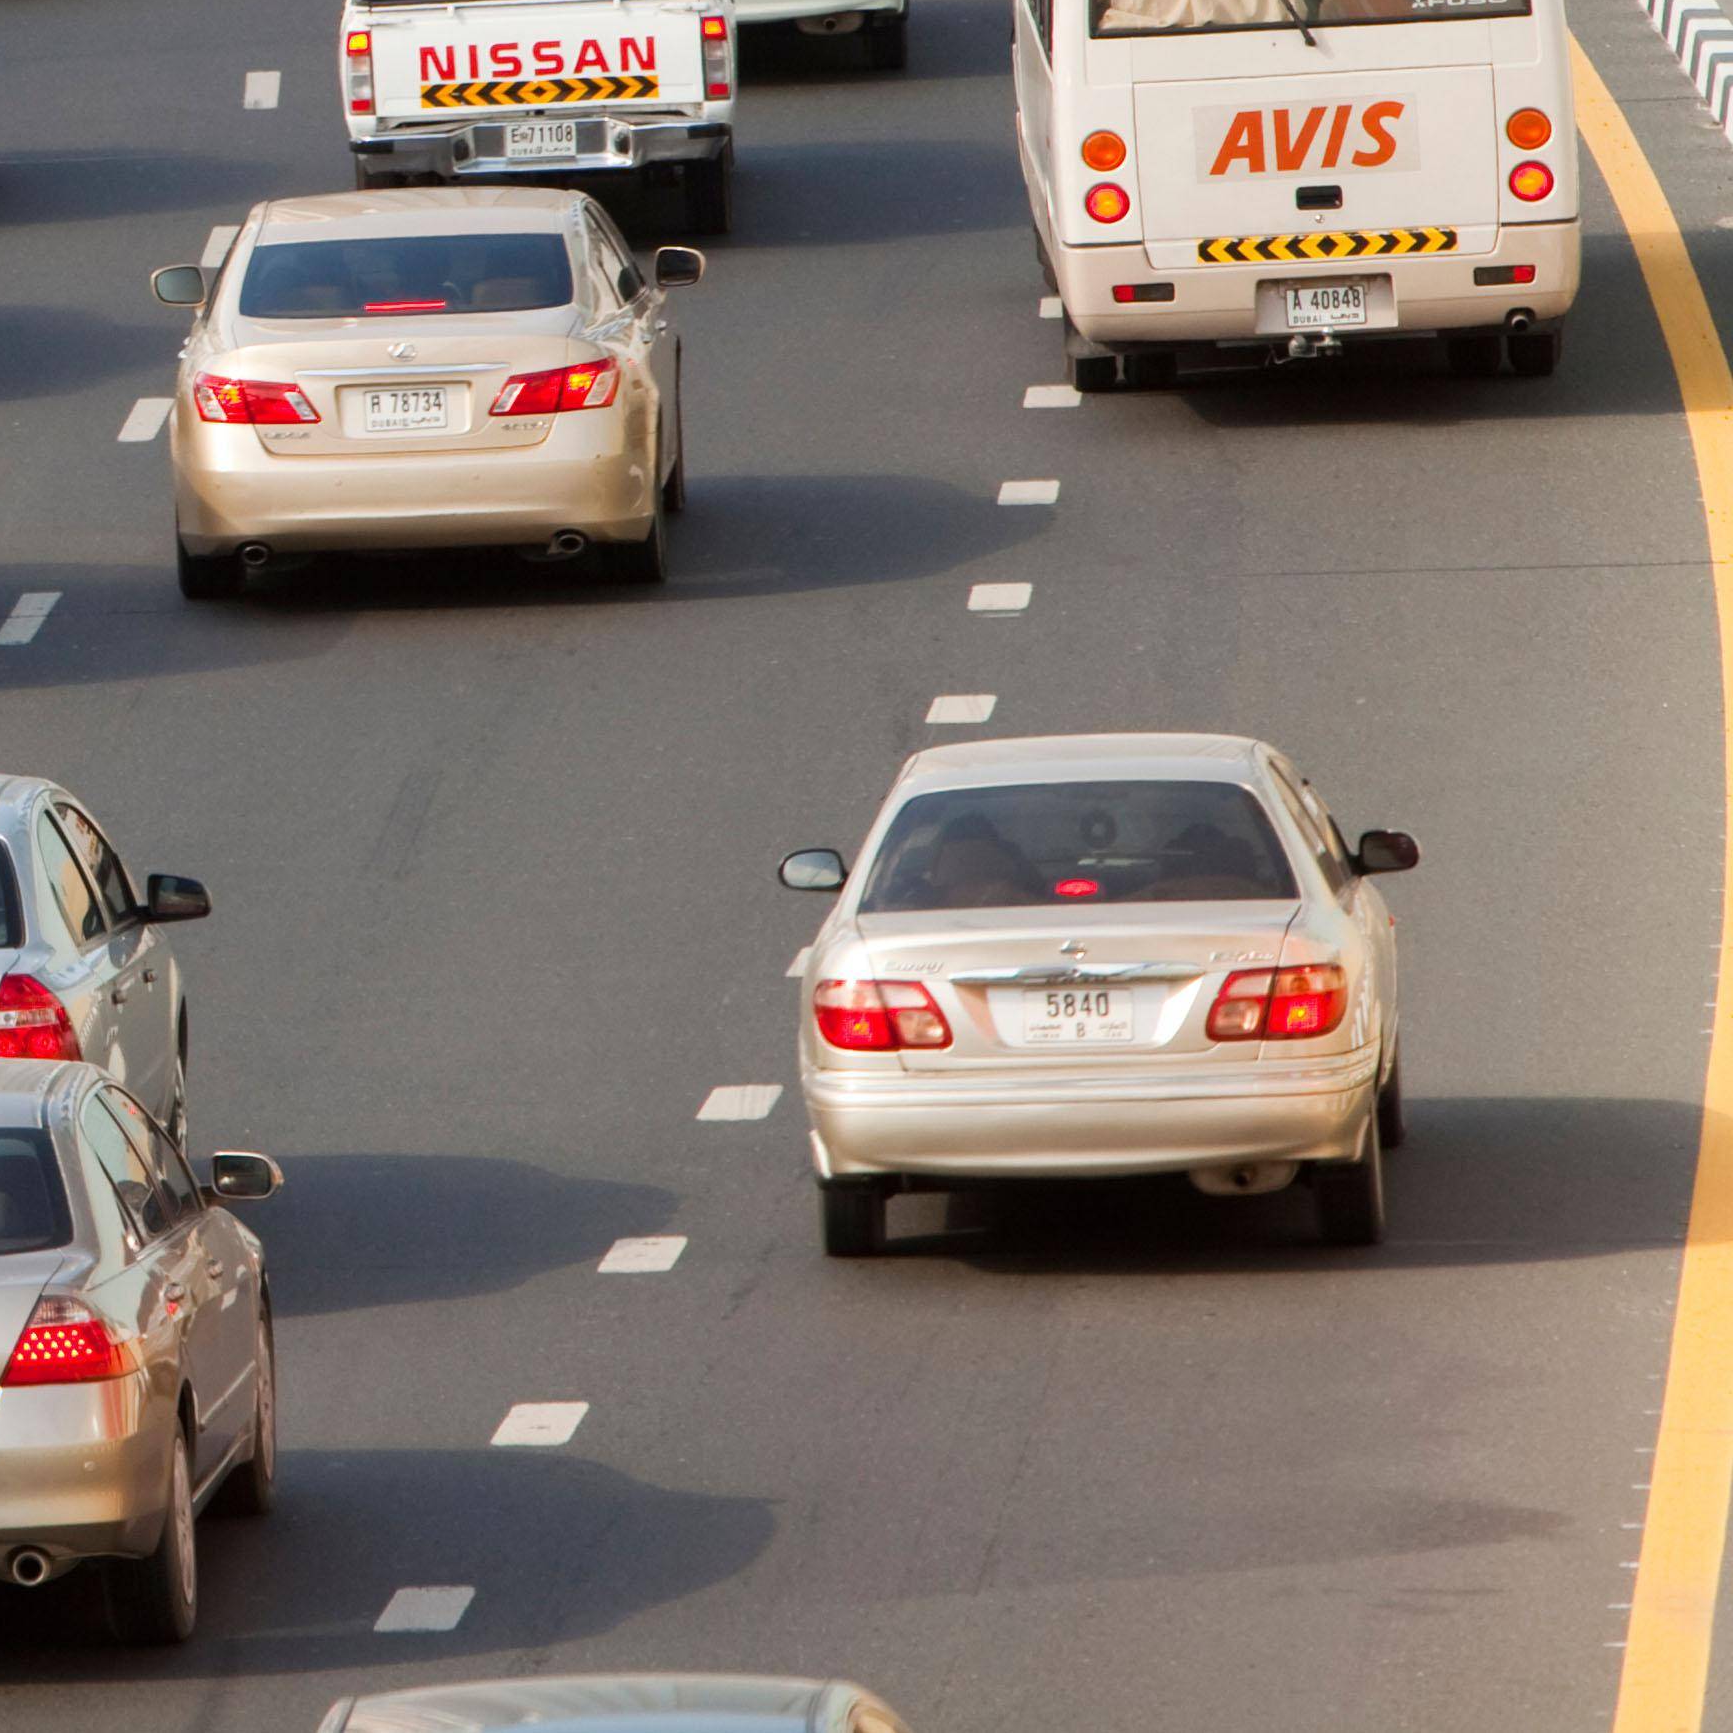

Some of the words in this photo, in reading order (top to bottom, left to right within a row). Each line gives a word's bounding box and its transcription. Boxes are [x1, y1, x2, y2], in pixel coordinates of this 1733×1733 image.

[420, 35, 657, 81] NISSAN
[512, 127, 519, 143] E
[529, 124, 573, 143] 71108
[1209, 101, 1406, 177] AVIS
[1293, 290, 1302, 311] A
[1310, 288, 1361, 311] 40848
[1293, 315, 1322, 324] DUBAI
[390, 391, 442, 413] 78734
[1046, 992, 1110, 1018] 5840
[1076, 1022, 1086, 1038] B
